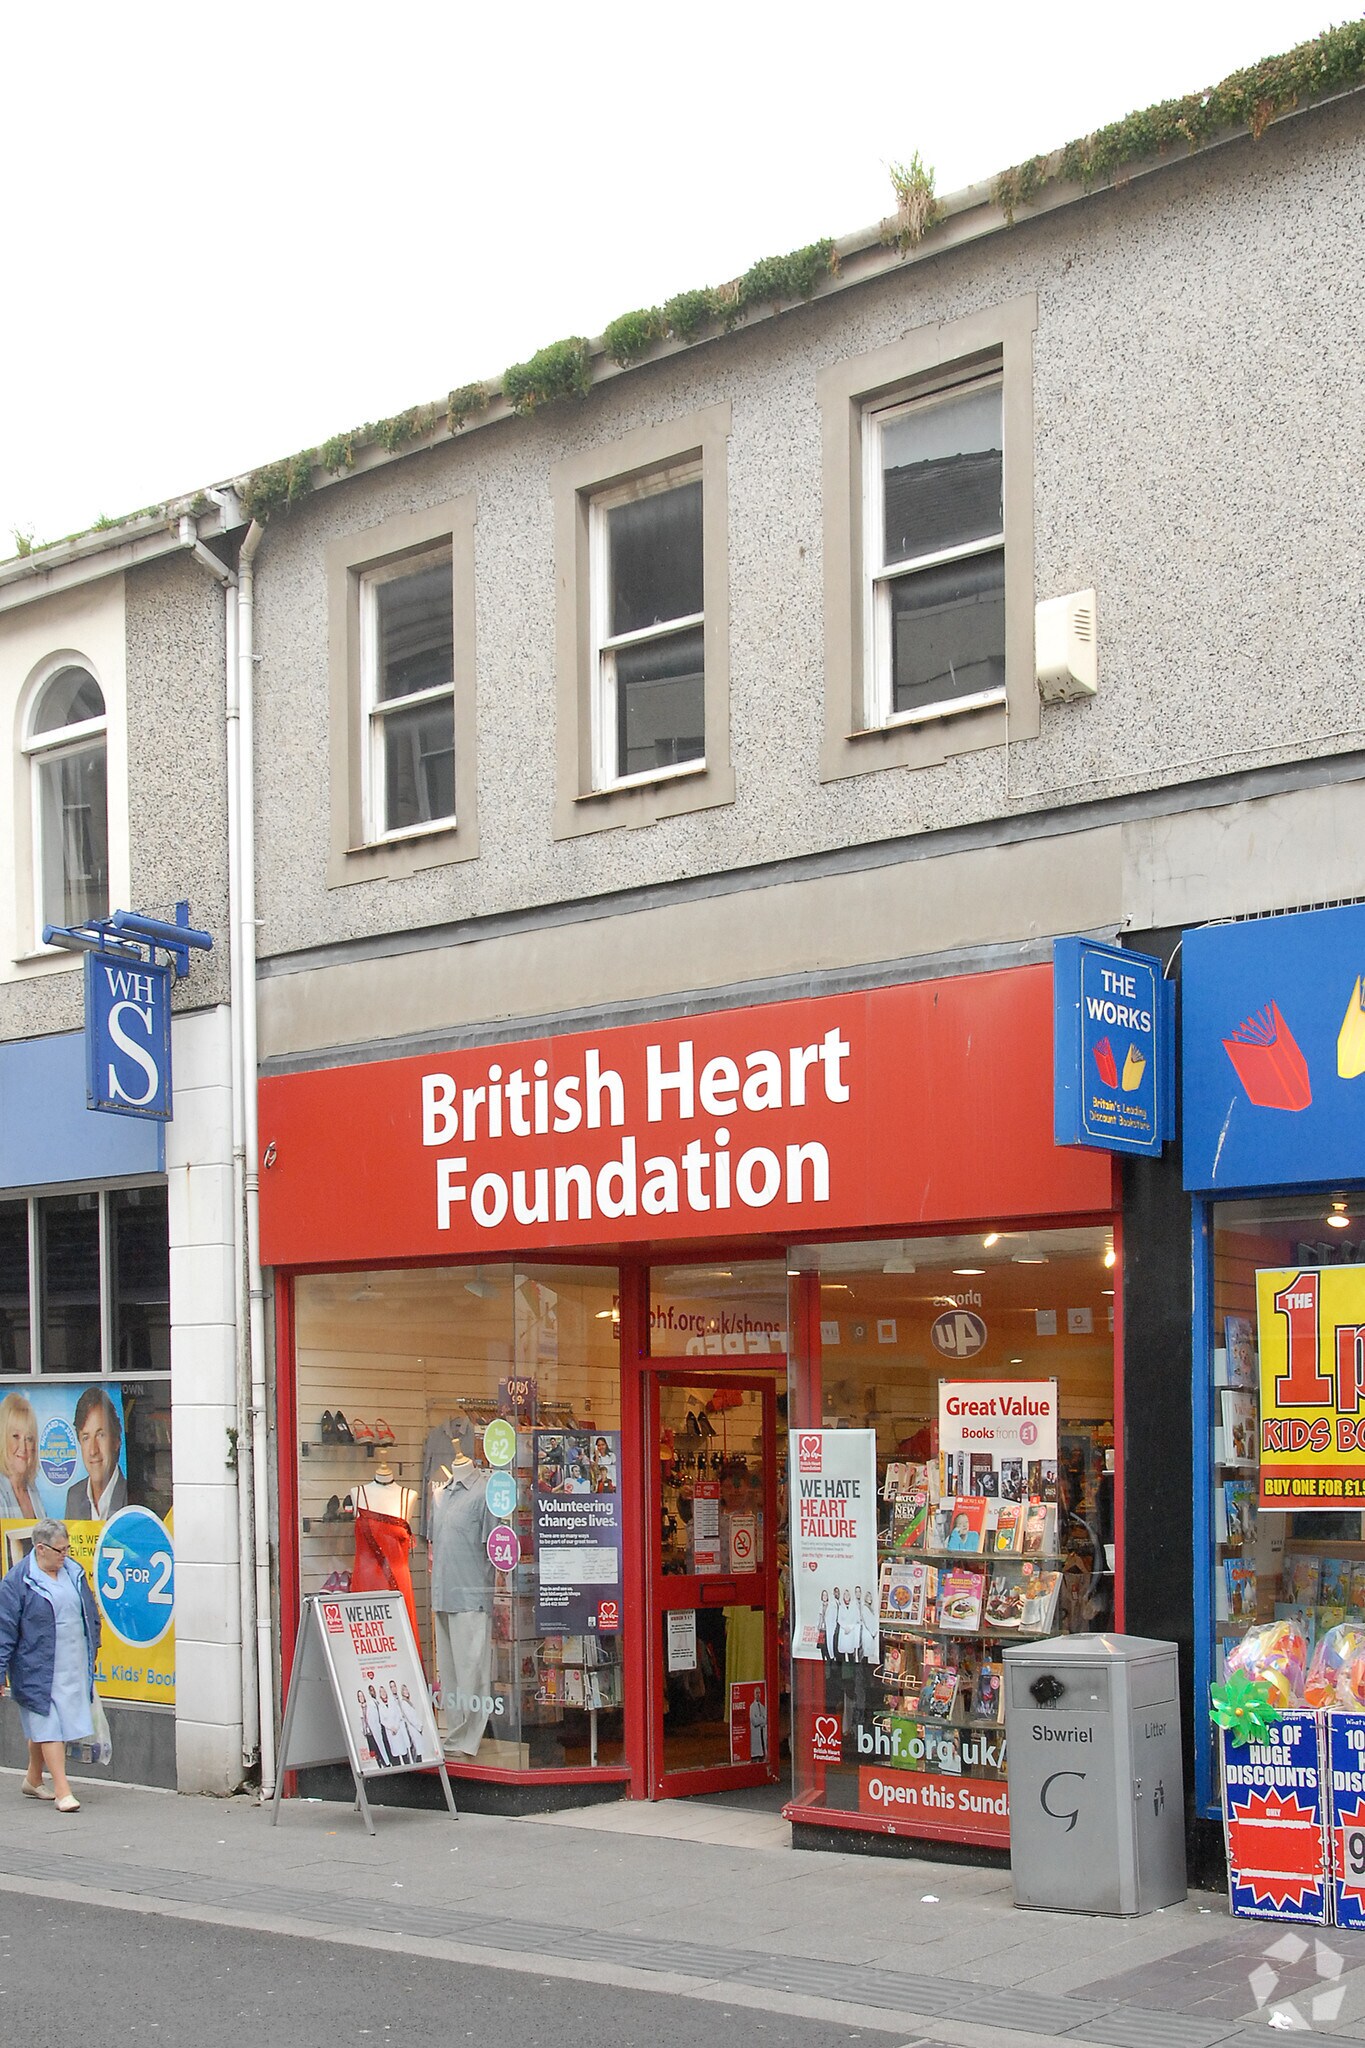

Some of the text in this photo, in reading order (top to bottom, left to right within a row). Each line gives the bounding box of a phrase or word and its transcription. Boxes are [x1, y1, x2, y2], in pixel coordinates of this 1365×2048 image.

[104, 966, 155, 1005] WH
[1101, 969, 1136, 999] THE
[1086, 996, 1152, 1032] WORKS
[108, 1000, 159, 1106] S
[422, 1027, 851, 1147] British Heart
[1093, 1096, 1121, 1112] Britain's
[1090, 1110, 1116, 1124] Discount
[437, 1127, 830, 1230] Foundation
[1286, 1293, 1313, 1309] THE
[946, 1395, 1050, 1416] Great Value
[962, 1425, 1034, 1441] Books from £1
[1262, 1419, 1330, 1452] KIDS
[491, 1438, 509, 1459] £2
[800, 1480, 860, 1498] WE HATE
[1265, 1479, 1365, 1496] BUY ONE FOR £1.
[493, 1490, 510, 1510] £5
[538, 1499, 614, 1515] Volunteering
[800, 1499, 847, 1517] HEART
[538, 1514, 618, 1529] changes lives.
[801, 1519, 857, 1538] FAILURE
[494, 1544, 512, 1565] £4
[101, 1547, 173, 1605] 3 FOR 2
[345, 1604, 392, 1622] WE HATE
[349, 1621, 385, 1638] HEART
[353, 1637, 397, 1655] FAILURE
[112, 1665, 143, 1682] Kids'
[1032, 1725, 1093, 1743] Sbwriel
[1145, 1723, 1167, 1739] Litter
[1282, 1725, 1302, 1745] OF
[1249, 1745, 1292, 1765] HUGE
[1226, 1765, 1317, 1788] DISCOUNTS
[1333, 1771, 1365, 1793] DIS
[868, 1778, 917, 1806] Open
[921, 1785, 955, 1807] this
